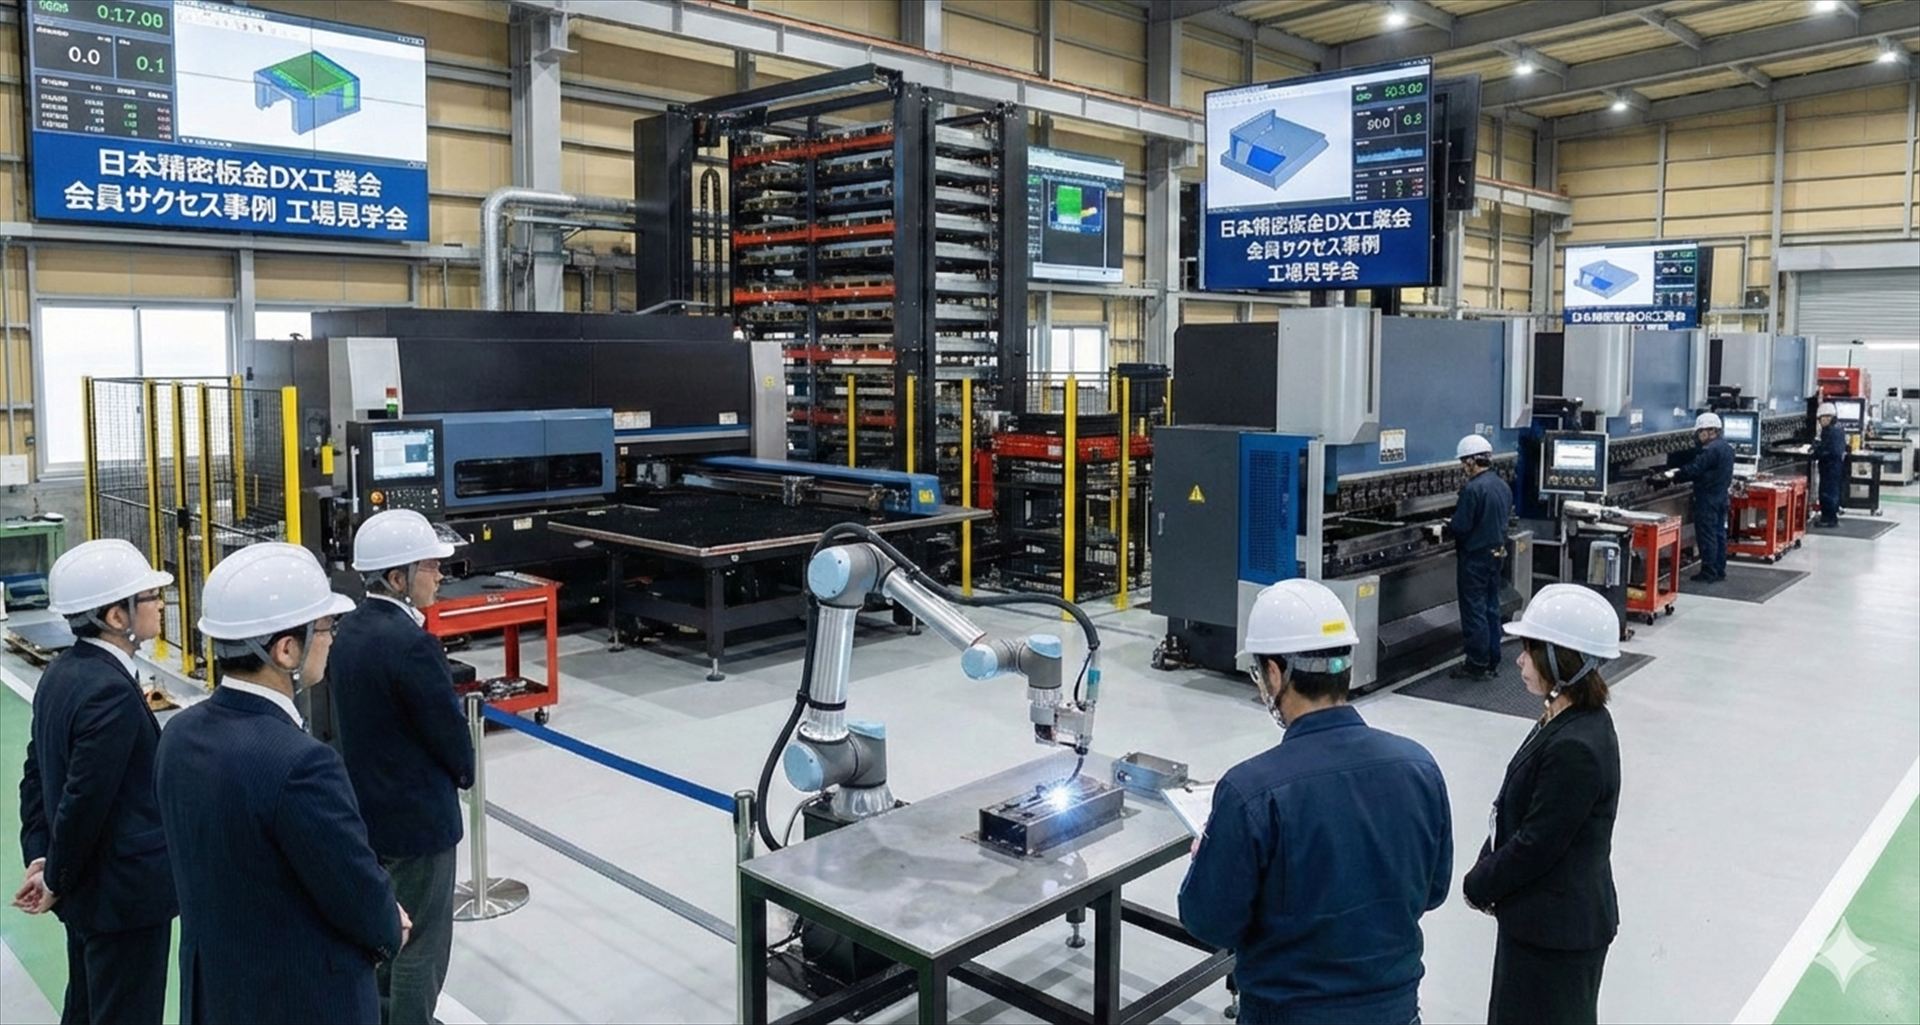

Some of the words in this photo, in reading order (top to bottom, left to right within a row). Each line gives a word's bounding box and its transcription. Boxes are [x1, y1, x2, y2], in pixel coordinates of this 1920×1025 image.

[68, 46, 100, 65] 0.0
[136, 56, 164, 73] 0.1
[99, 148, 382, 198] 日本精密板金DX工業会
[64, 180, 277, 223] 会員サクセス事例
[285, 199, 409, 231] 工場見学会
